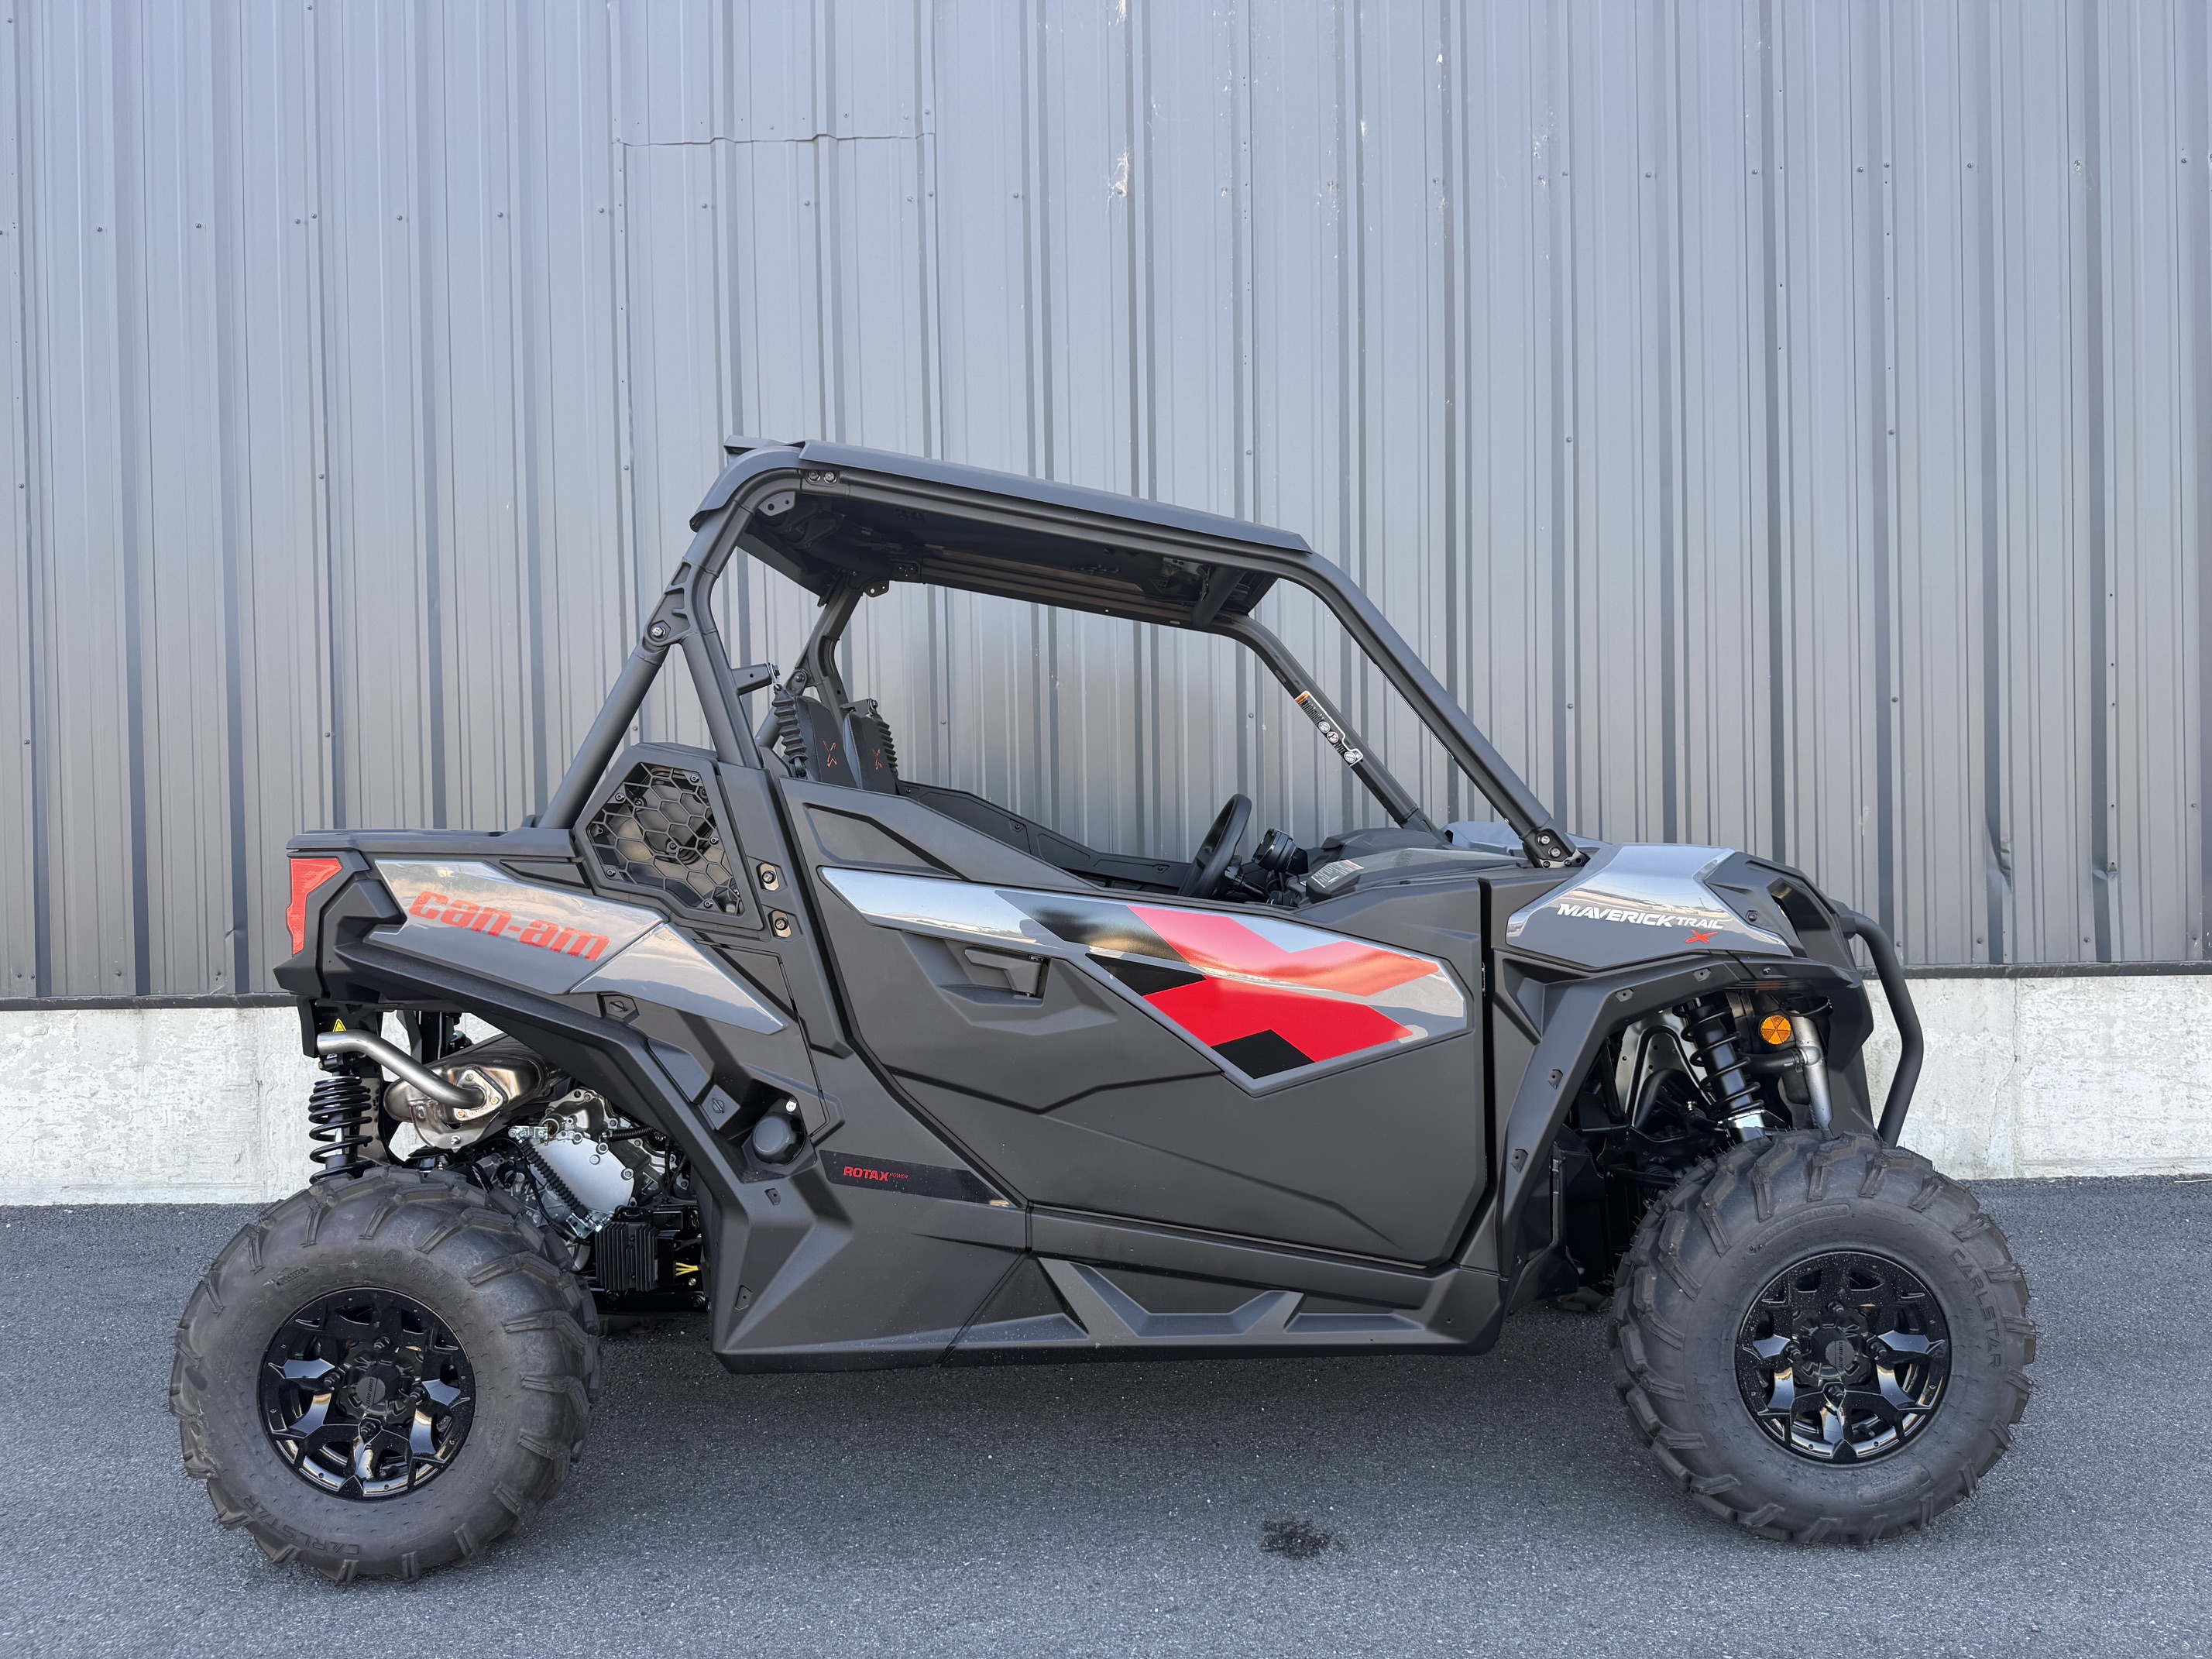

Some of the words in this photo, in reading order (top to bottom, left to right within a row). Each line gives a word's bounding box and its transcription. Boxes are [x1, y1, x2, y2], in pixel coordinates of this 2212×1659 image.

[1557, 903, 1678, 928] MAVERICK
[1677, 916, 1723, 929] TRAIL
[843, 1166, 890, 1182] ROTAX
[1949, 1249, 2003, 1369] CARLSTAR
[242, 1494, 361, 1557] CARLSTAR
